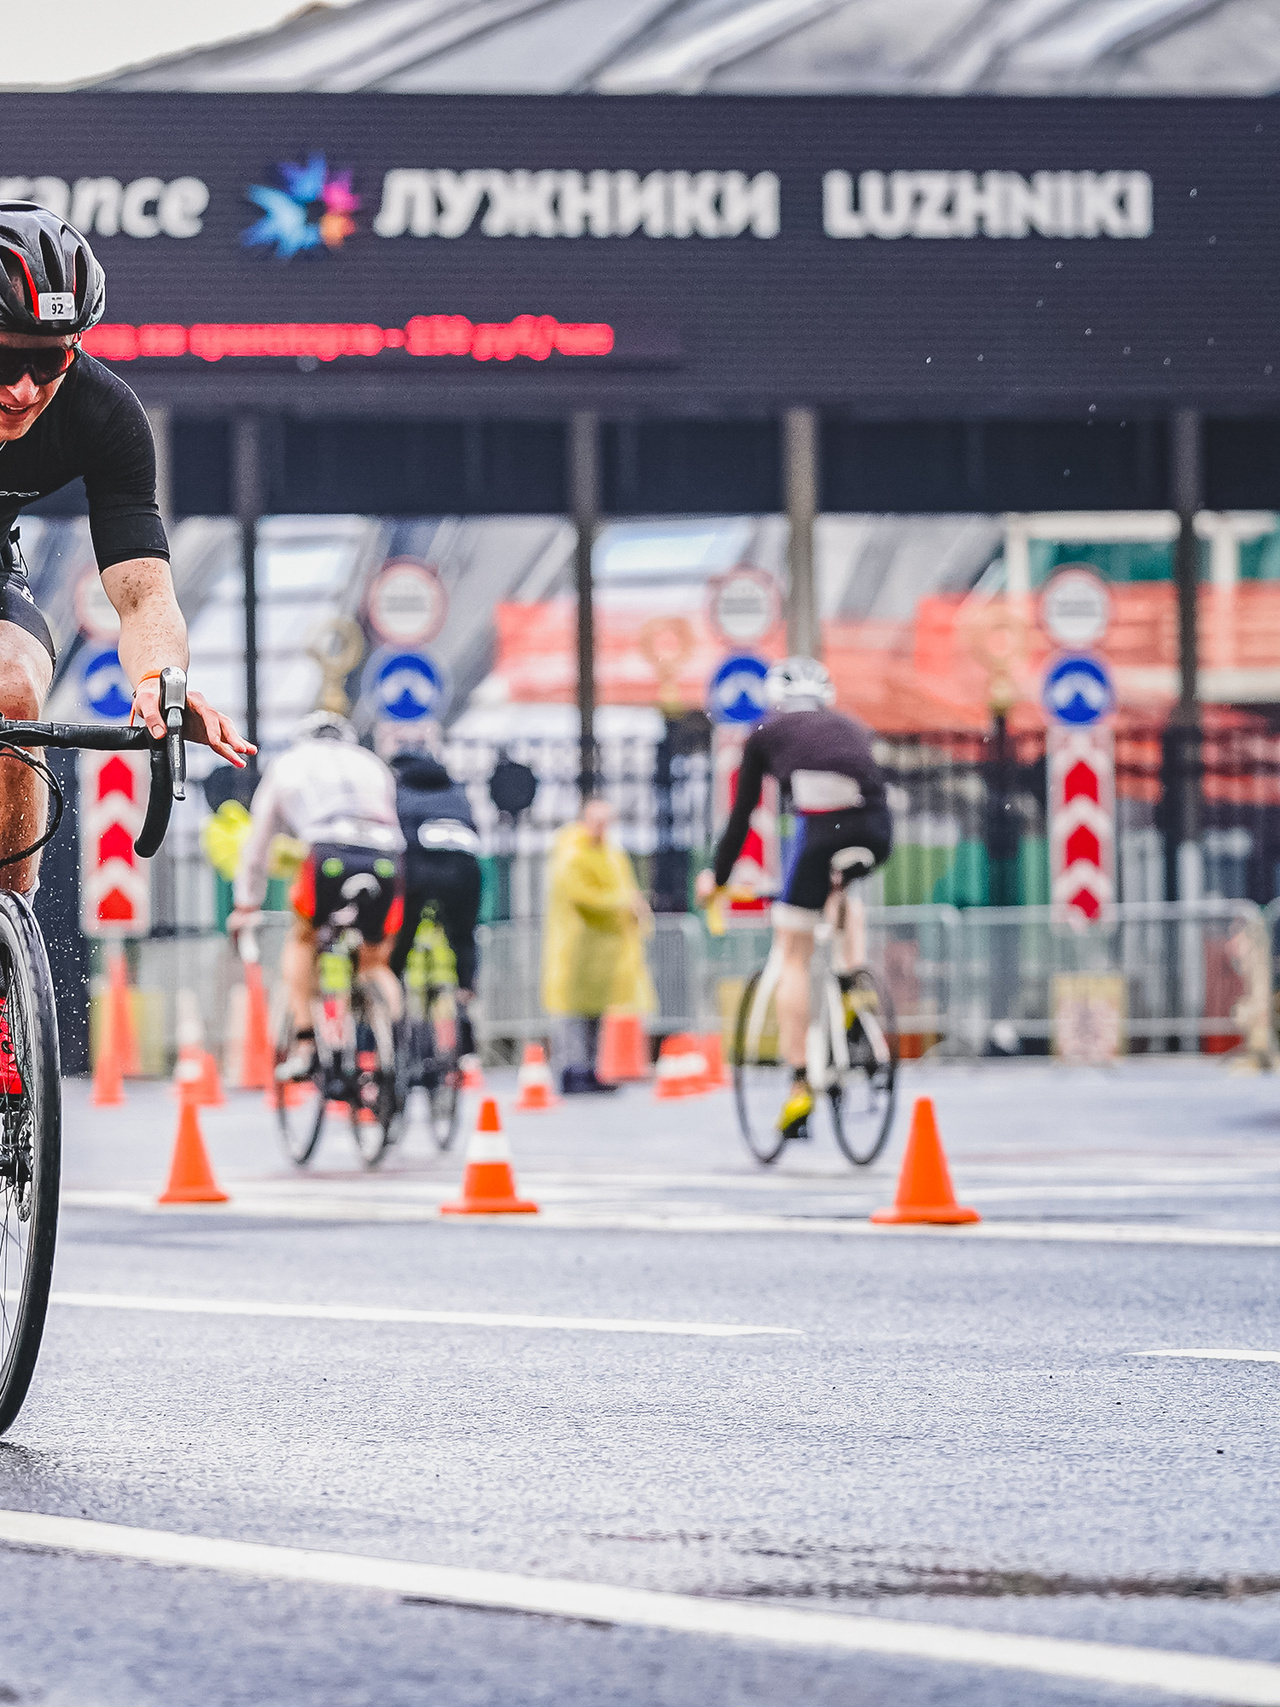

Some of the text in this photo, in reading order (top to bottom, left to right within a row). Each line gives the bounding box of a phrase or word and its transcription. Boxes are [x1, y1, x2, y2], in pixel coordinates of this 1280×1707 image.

[373, 168, 781, 239] ЛУЖНИКИ
[822, 169, 1154, 239] LUZHNIKI
[51, 303, 64, 315] 92
